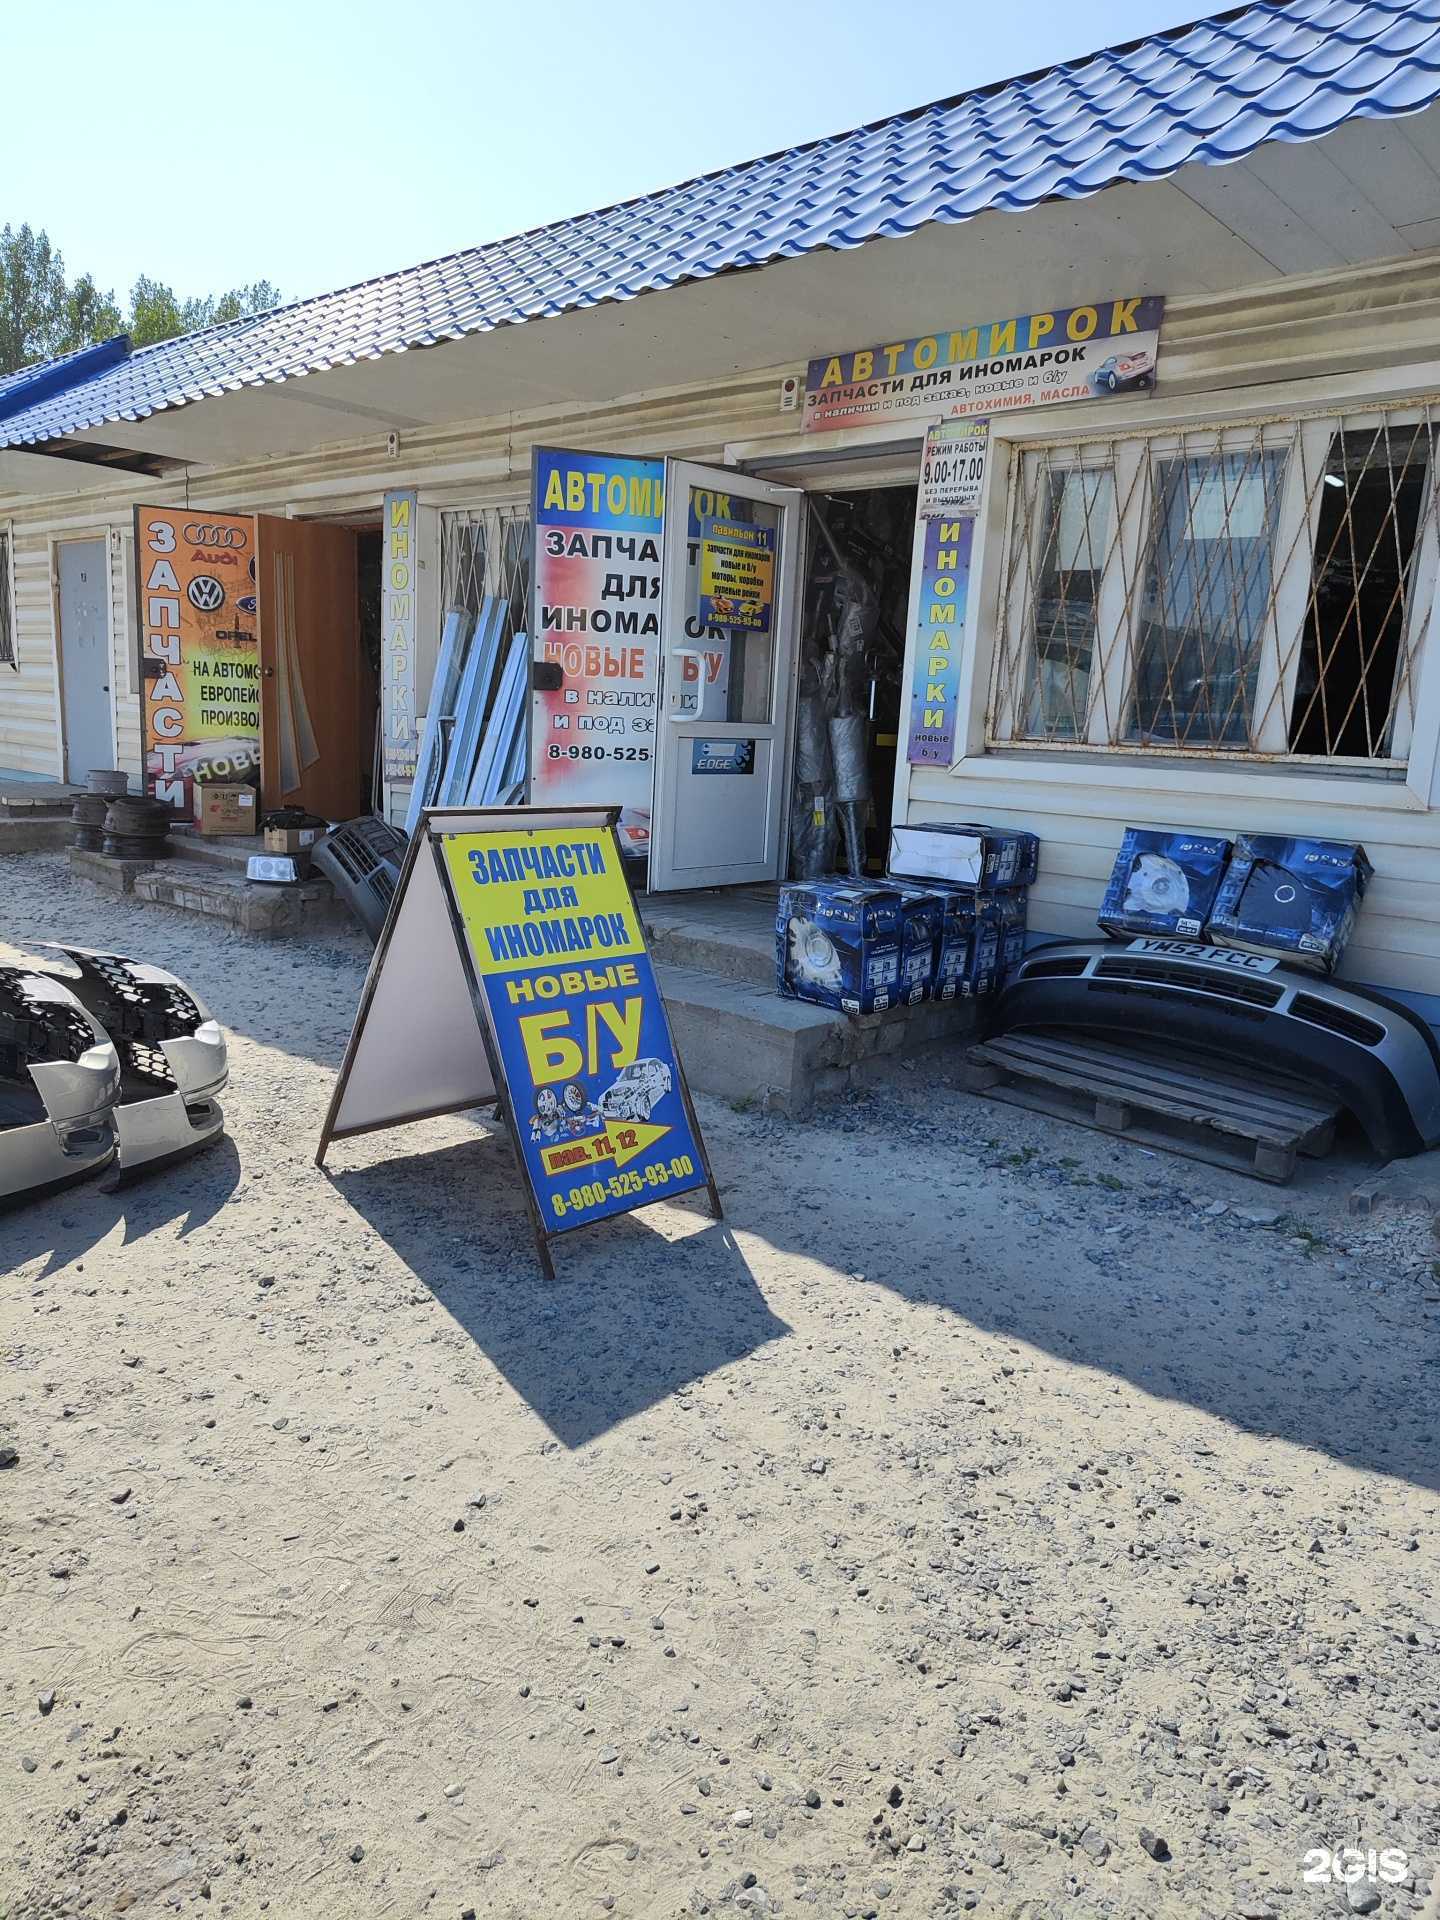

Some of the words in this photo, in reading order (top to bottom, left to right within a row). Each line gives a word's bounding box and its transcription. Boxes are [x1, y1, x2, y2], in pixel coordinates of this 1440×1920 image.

[820, 297, 1142, 388] АВТОМИРОК
[807, 380, 904, 407] ЗАПЧАСТИ
[910, 370, 951, 392] ДЛЯ
[959, 346, 1086, 381] ИНОМАРОК
[824, 402, 880, 418] наличии
[882, 400, 893, 410] и
[895, 396, 920, 408] под
[923, 387, 971, 402] заказ,
[975, 379, 1024, 395] новые
[1028, 375, 1039, 386] и
[1042, 369, 1067, 384] б/у
[951, 393, 1036, 416] АВТОХИМИЯ,
[1040, 385, 1090, 401] МАСЛА
[928, 424, 988, 440] АВТРОК
[927, 445, 953, 457] РЕЖИМ
[954, 441, 986, 454] РАБОТЫ
[924, 457, 983, 484] 9.00-17.00
[543, 469, 732, 521] АВТОМОК
[940, 485, 979, 494] ПЕРЕРЫВА
[757, 531, 767, 546] 11
[391, 499, 411, 741] ИНОМАРКИ
[541, 606, 726, 640] ИНОМАОК
[923, 523, 961, 728] ИНОМАРКИ
[147, 521, 185, 808] ЗАПЧАСТИ
[193, 661, 210, 677] НА
[682, 652, 723, 683] БУ
[564, 690, 579, 703] в
[201, 710, 260, 728] ПРОИЗВО
[553, 714, 570, 729] и
[578, 715, 625, 734] под
[915, 735, 949, 743] новые
[697, 759, 733, 769] EDGE
[468, 843, 606, 885] ЗАПЧАСТИ
[523, 886, 579, 915] ДЛЯ
[485, 913, 630, 962] ИНОМАРОК
[1141, 940, 1206, 957] YM52
[1208, 949, 1264, 968] FCC
[505, 963, 640, 1004] НОВЫЕ
[519, 997, 643, 1086] Б/У
[592, 1135, 616, 1157] 11,
[616, 1129, 639, 1149] 12
[551, 1155, 694, 1217] 8-980-525-93-00
